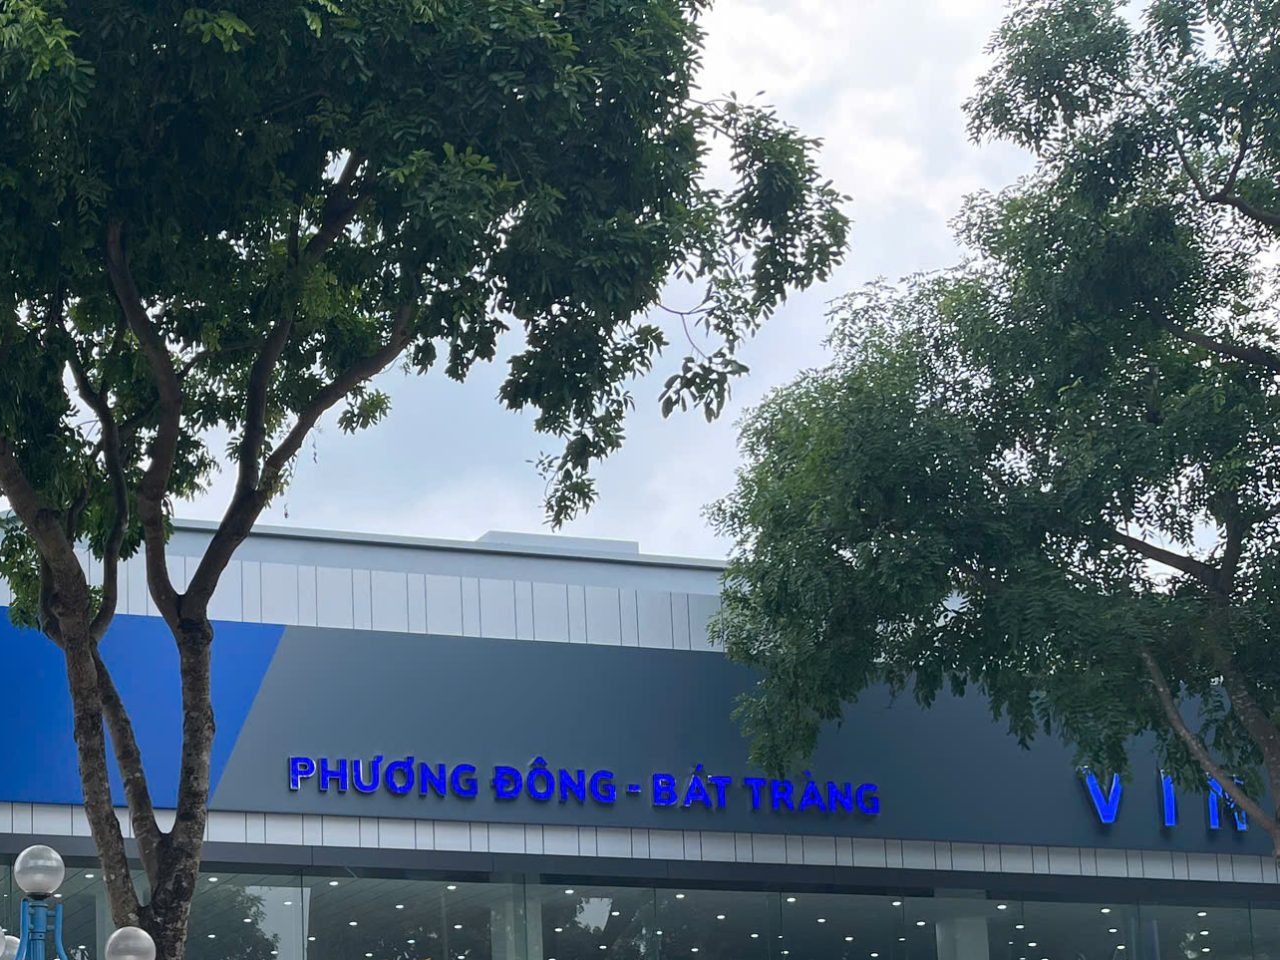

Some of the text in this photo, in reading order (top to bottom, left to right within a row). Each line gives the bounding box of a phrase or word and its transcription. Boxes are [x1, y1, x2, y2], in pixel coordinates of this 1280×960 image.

[288, 756, 880, 815] PHƯƠNG ĐÔNG - BÁT TRÀNG
